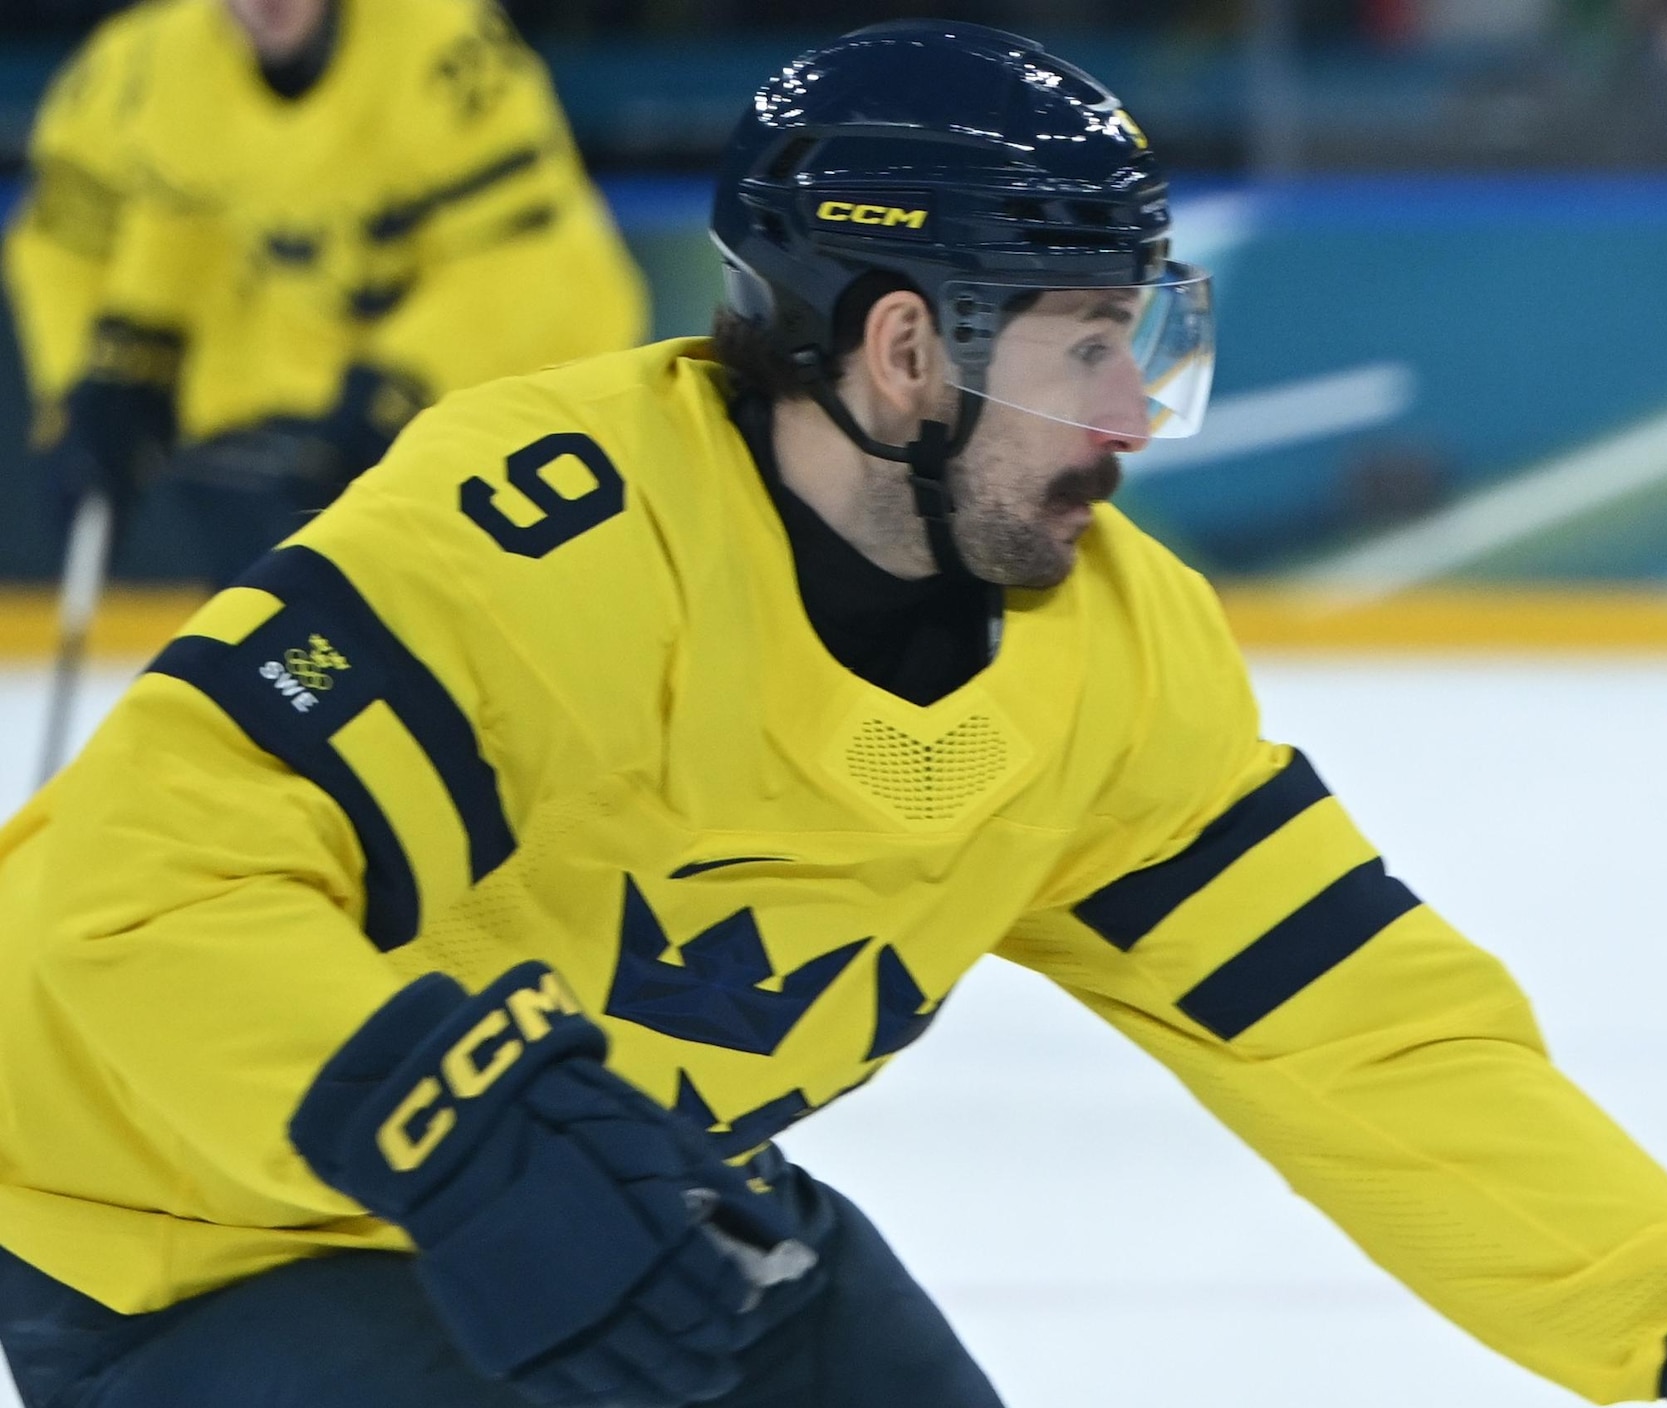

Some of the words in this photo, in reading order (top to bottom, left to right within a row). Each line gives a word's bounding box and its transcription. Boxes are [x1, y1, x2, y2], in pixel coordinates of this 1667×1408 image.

[815, 200, 929, 229] CCM
[458, 431, 626, 561] 9
[258, 660, 320, 713] SWE
[374, 970, 584, 1174] CCM
